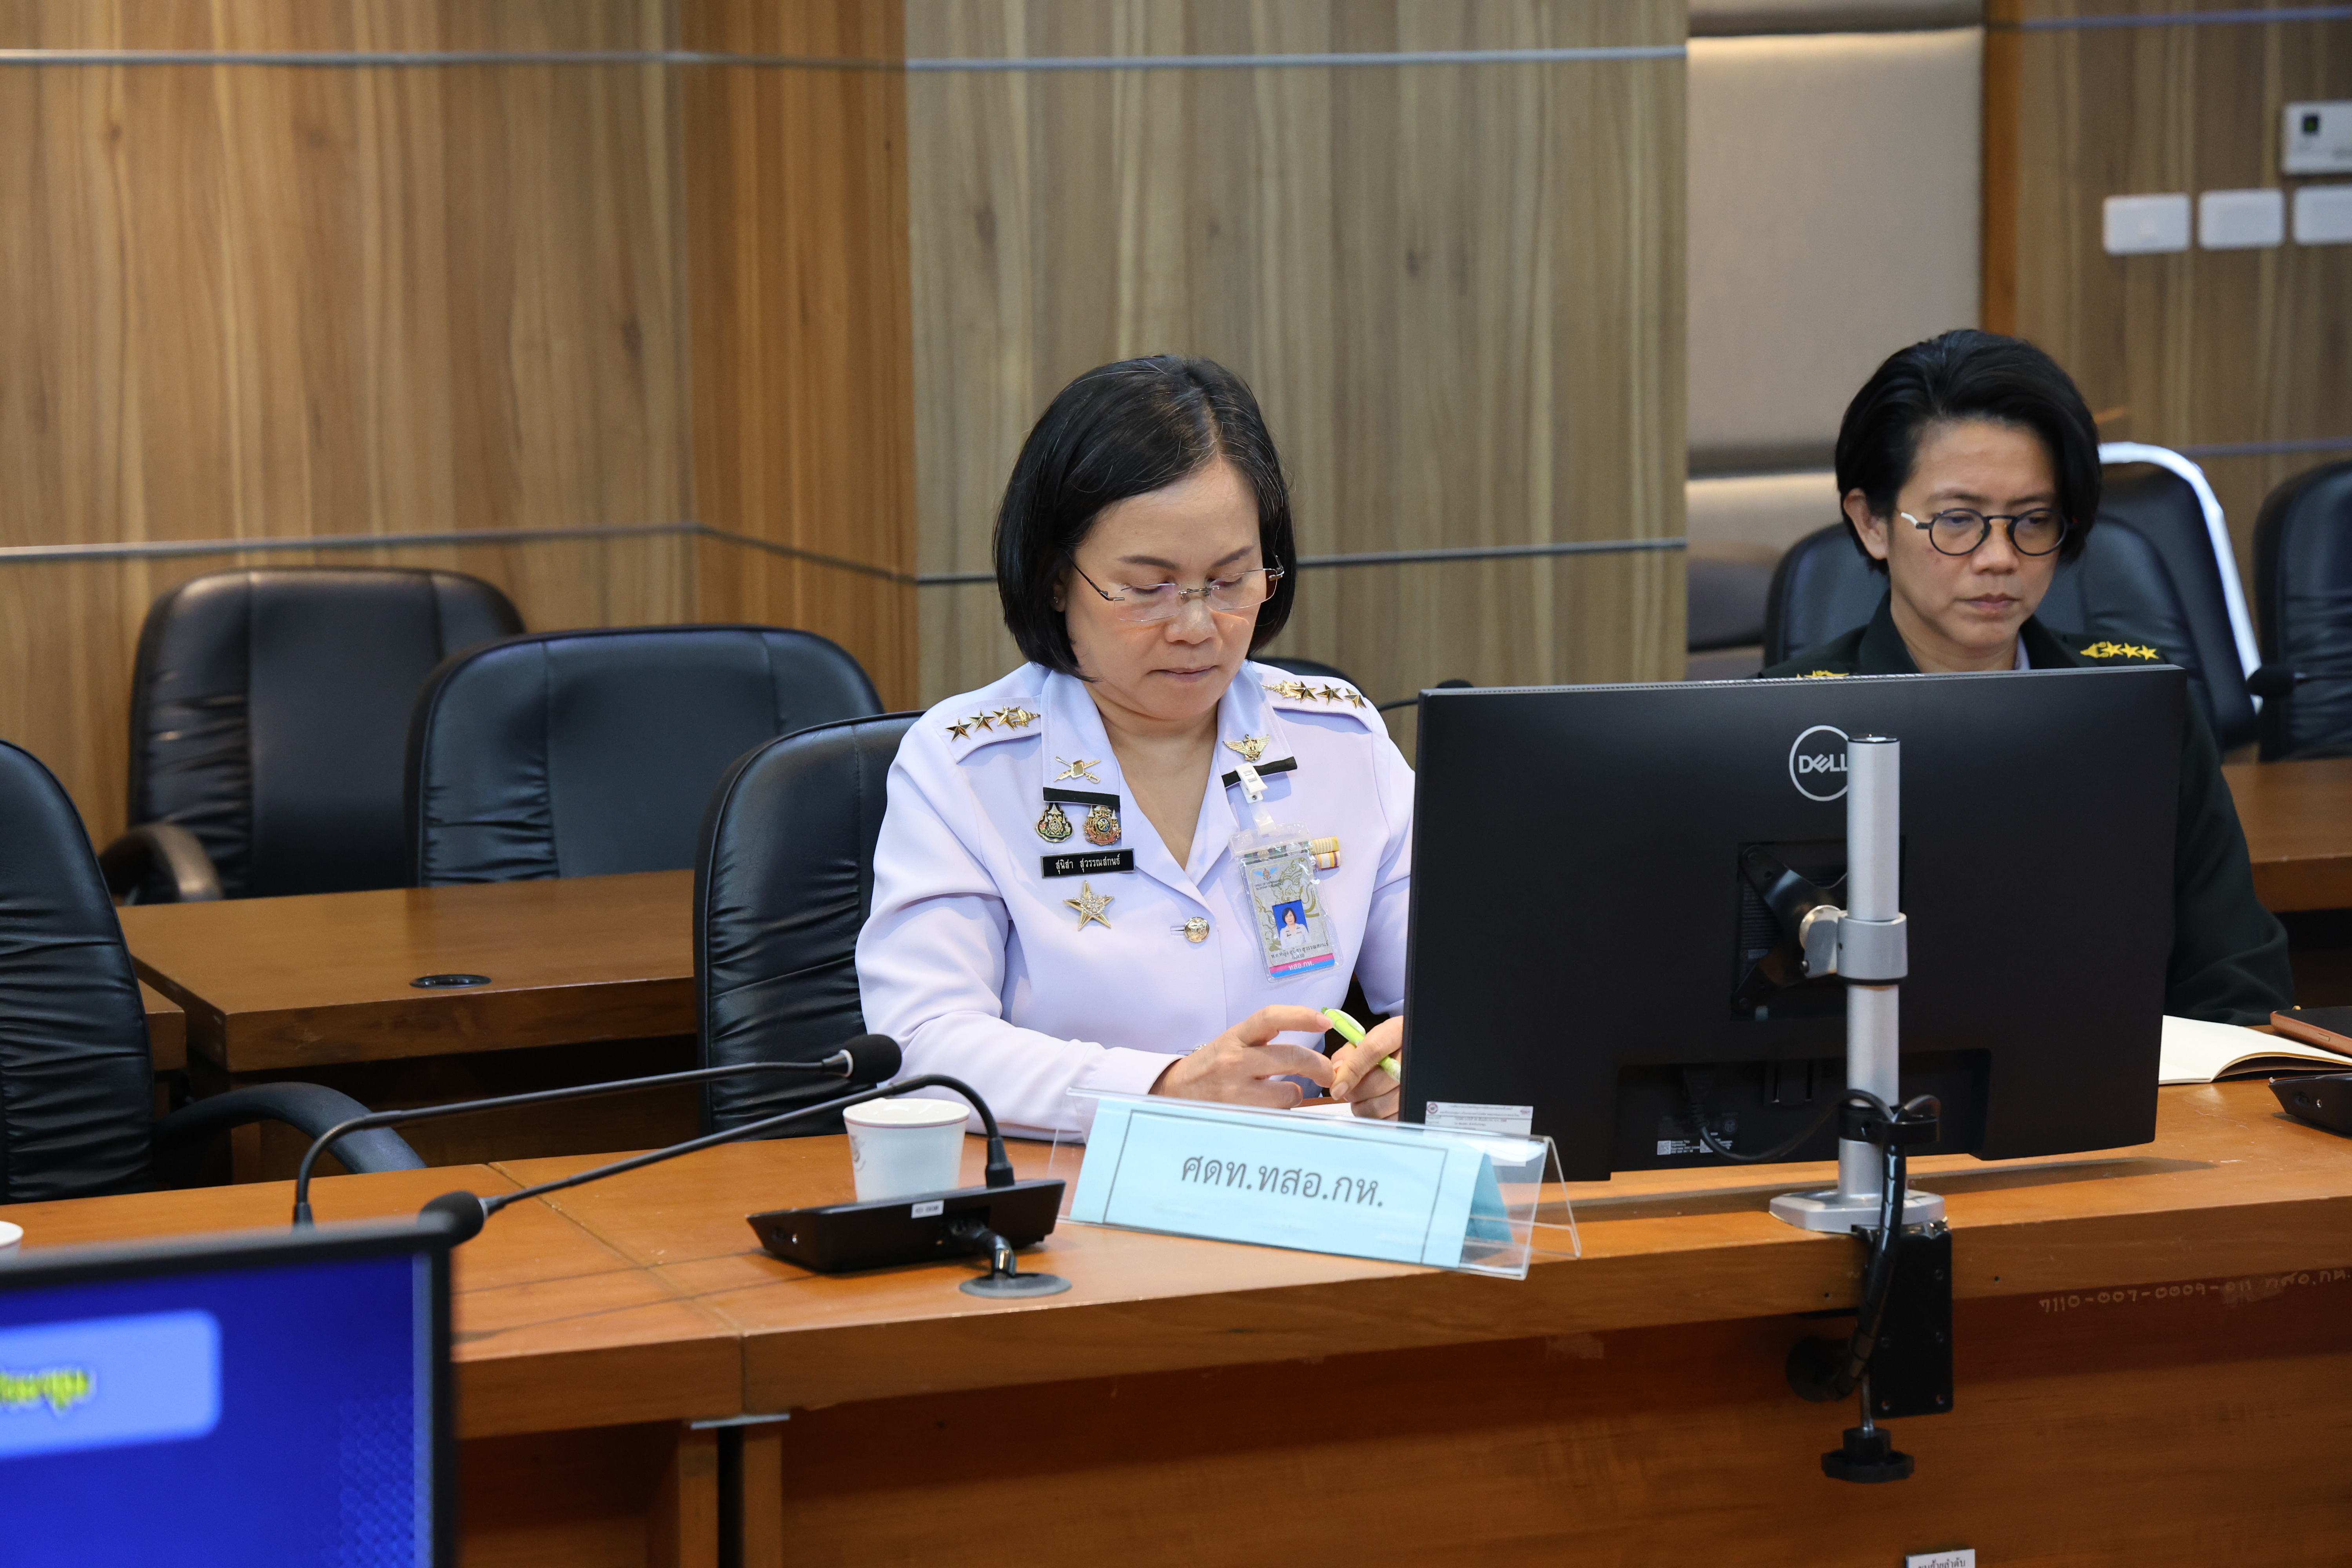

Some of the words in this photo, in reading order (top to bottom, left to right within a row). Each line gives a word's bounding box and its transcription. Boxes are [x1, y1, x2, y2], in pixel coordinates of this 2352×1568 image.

[1798, 753, 1848, 773] DELL
[1055, 858, 1074, 875] สุนิสา
[1080, 853, 1120, 873] สุวรรณสกนธ์
[1288, 960, 1314, 971] ทสอ.กห.
[1181, 1156, 1383, 1207] ศดท.ทสอ.กห.
